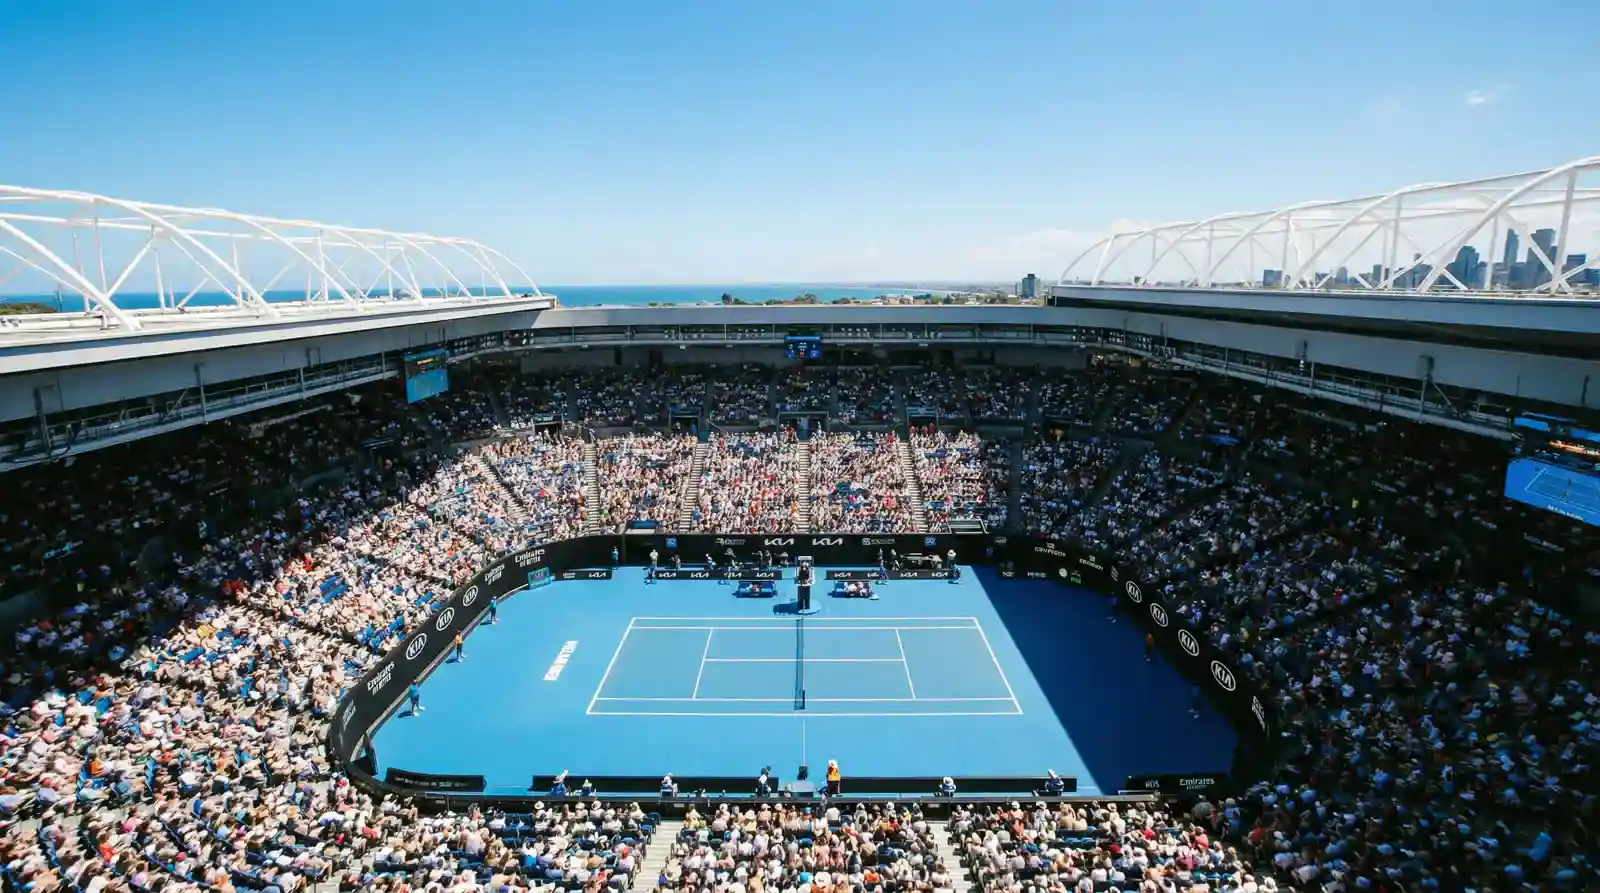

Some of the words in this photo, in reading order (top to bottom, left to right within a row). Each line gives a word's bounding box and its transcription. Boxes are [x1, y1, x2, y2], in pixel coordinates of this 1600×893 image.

[764, 538, 794, 546] KIA
[812, 538, 843, 546] KIA
[1180, 778, 1214, 786] Emirates
